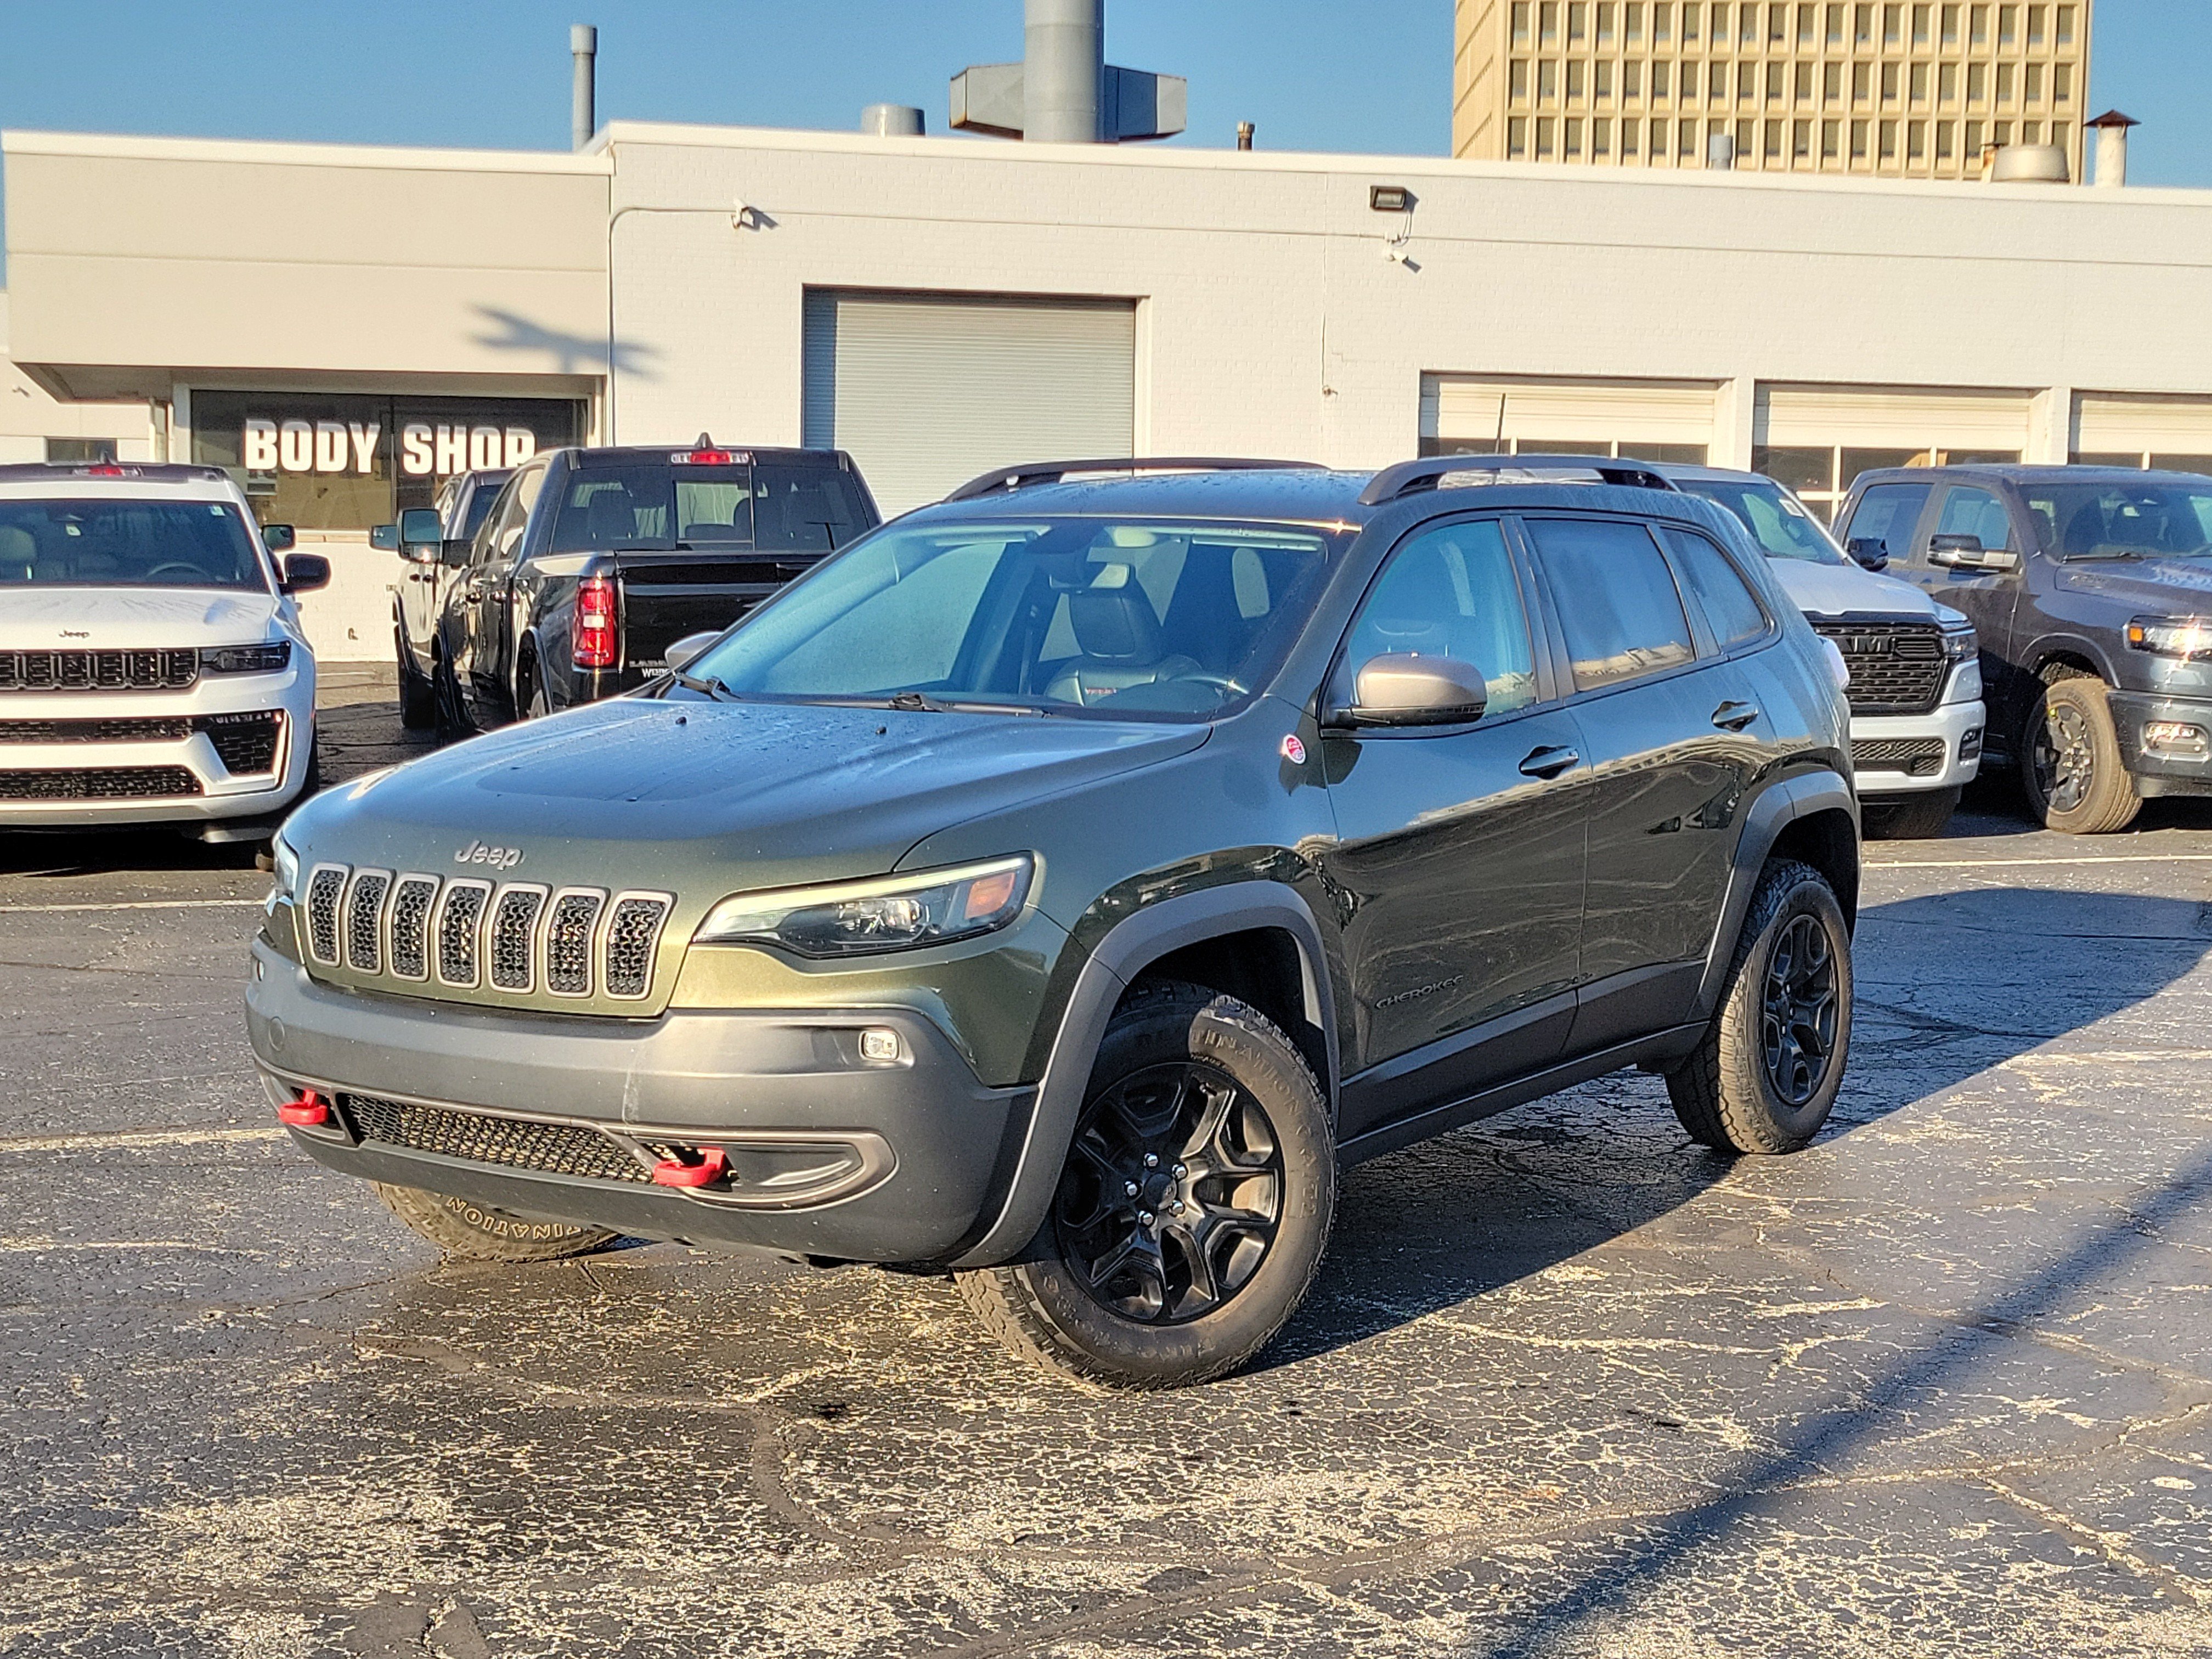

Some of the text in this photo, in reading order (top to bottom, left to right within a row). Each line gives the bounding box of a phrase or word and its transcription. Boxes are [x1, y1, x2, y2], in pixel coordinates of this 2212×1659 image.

[245, 418, 535, 475] BODY SHOP
[58, 629, 90, 639] Jeep
[1837, 635, 1891, 653] AM
[454, 840, 523, 871] Jeep
[1375, 974, 1464, 1009] CHEROKEE
[446, 1197, 582, 1240] TINATION
